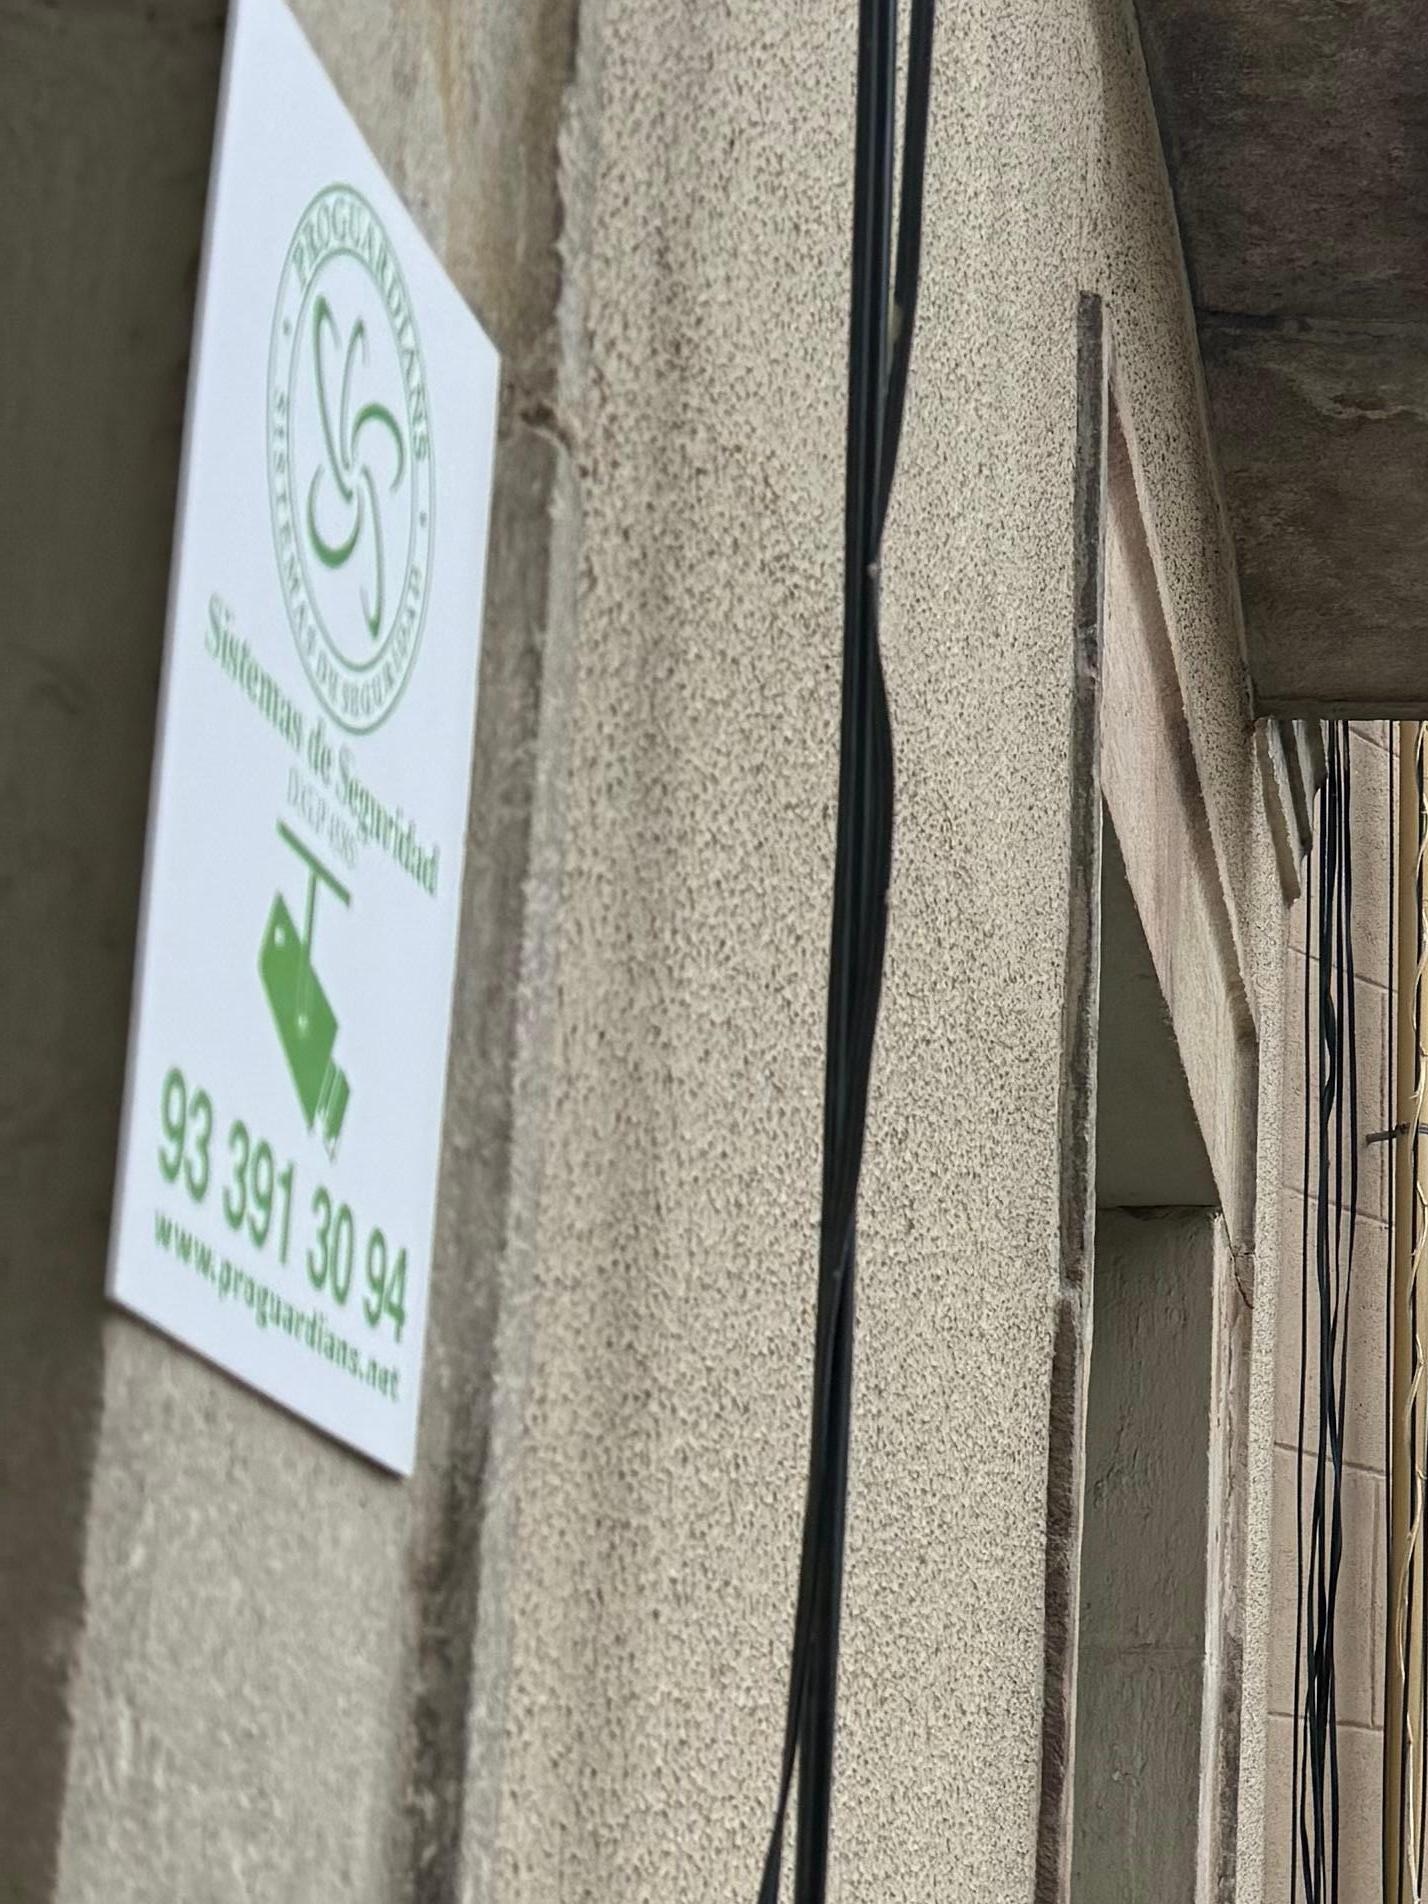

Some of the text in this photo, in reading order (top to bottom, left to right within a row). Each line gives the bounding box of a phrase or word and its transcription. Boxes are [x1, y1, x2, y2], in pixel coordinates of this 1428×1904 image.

[291, 194, 427, 461] PROGUARDIANS
[204, 592, 440, 896] Sistemas de Seguridad
[154, 1208, 401, 1402] www.proguardians.net
[157, 1066, 407, 1345] 93 391 30 94
